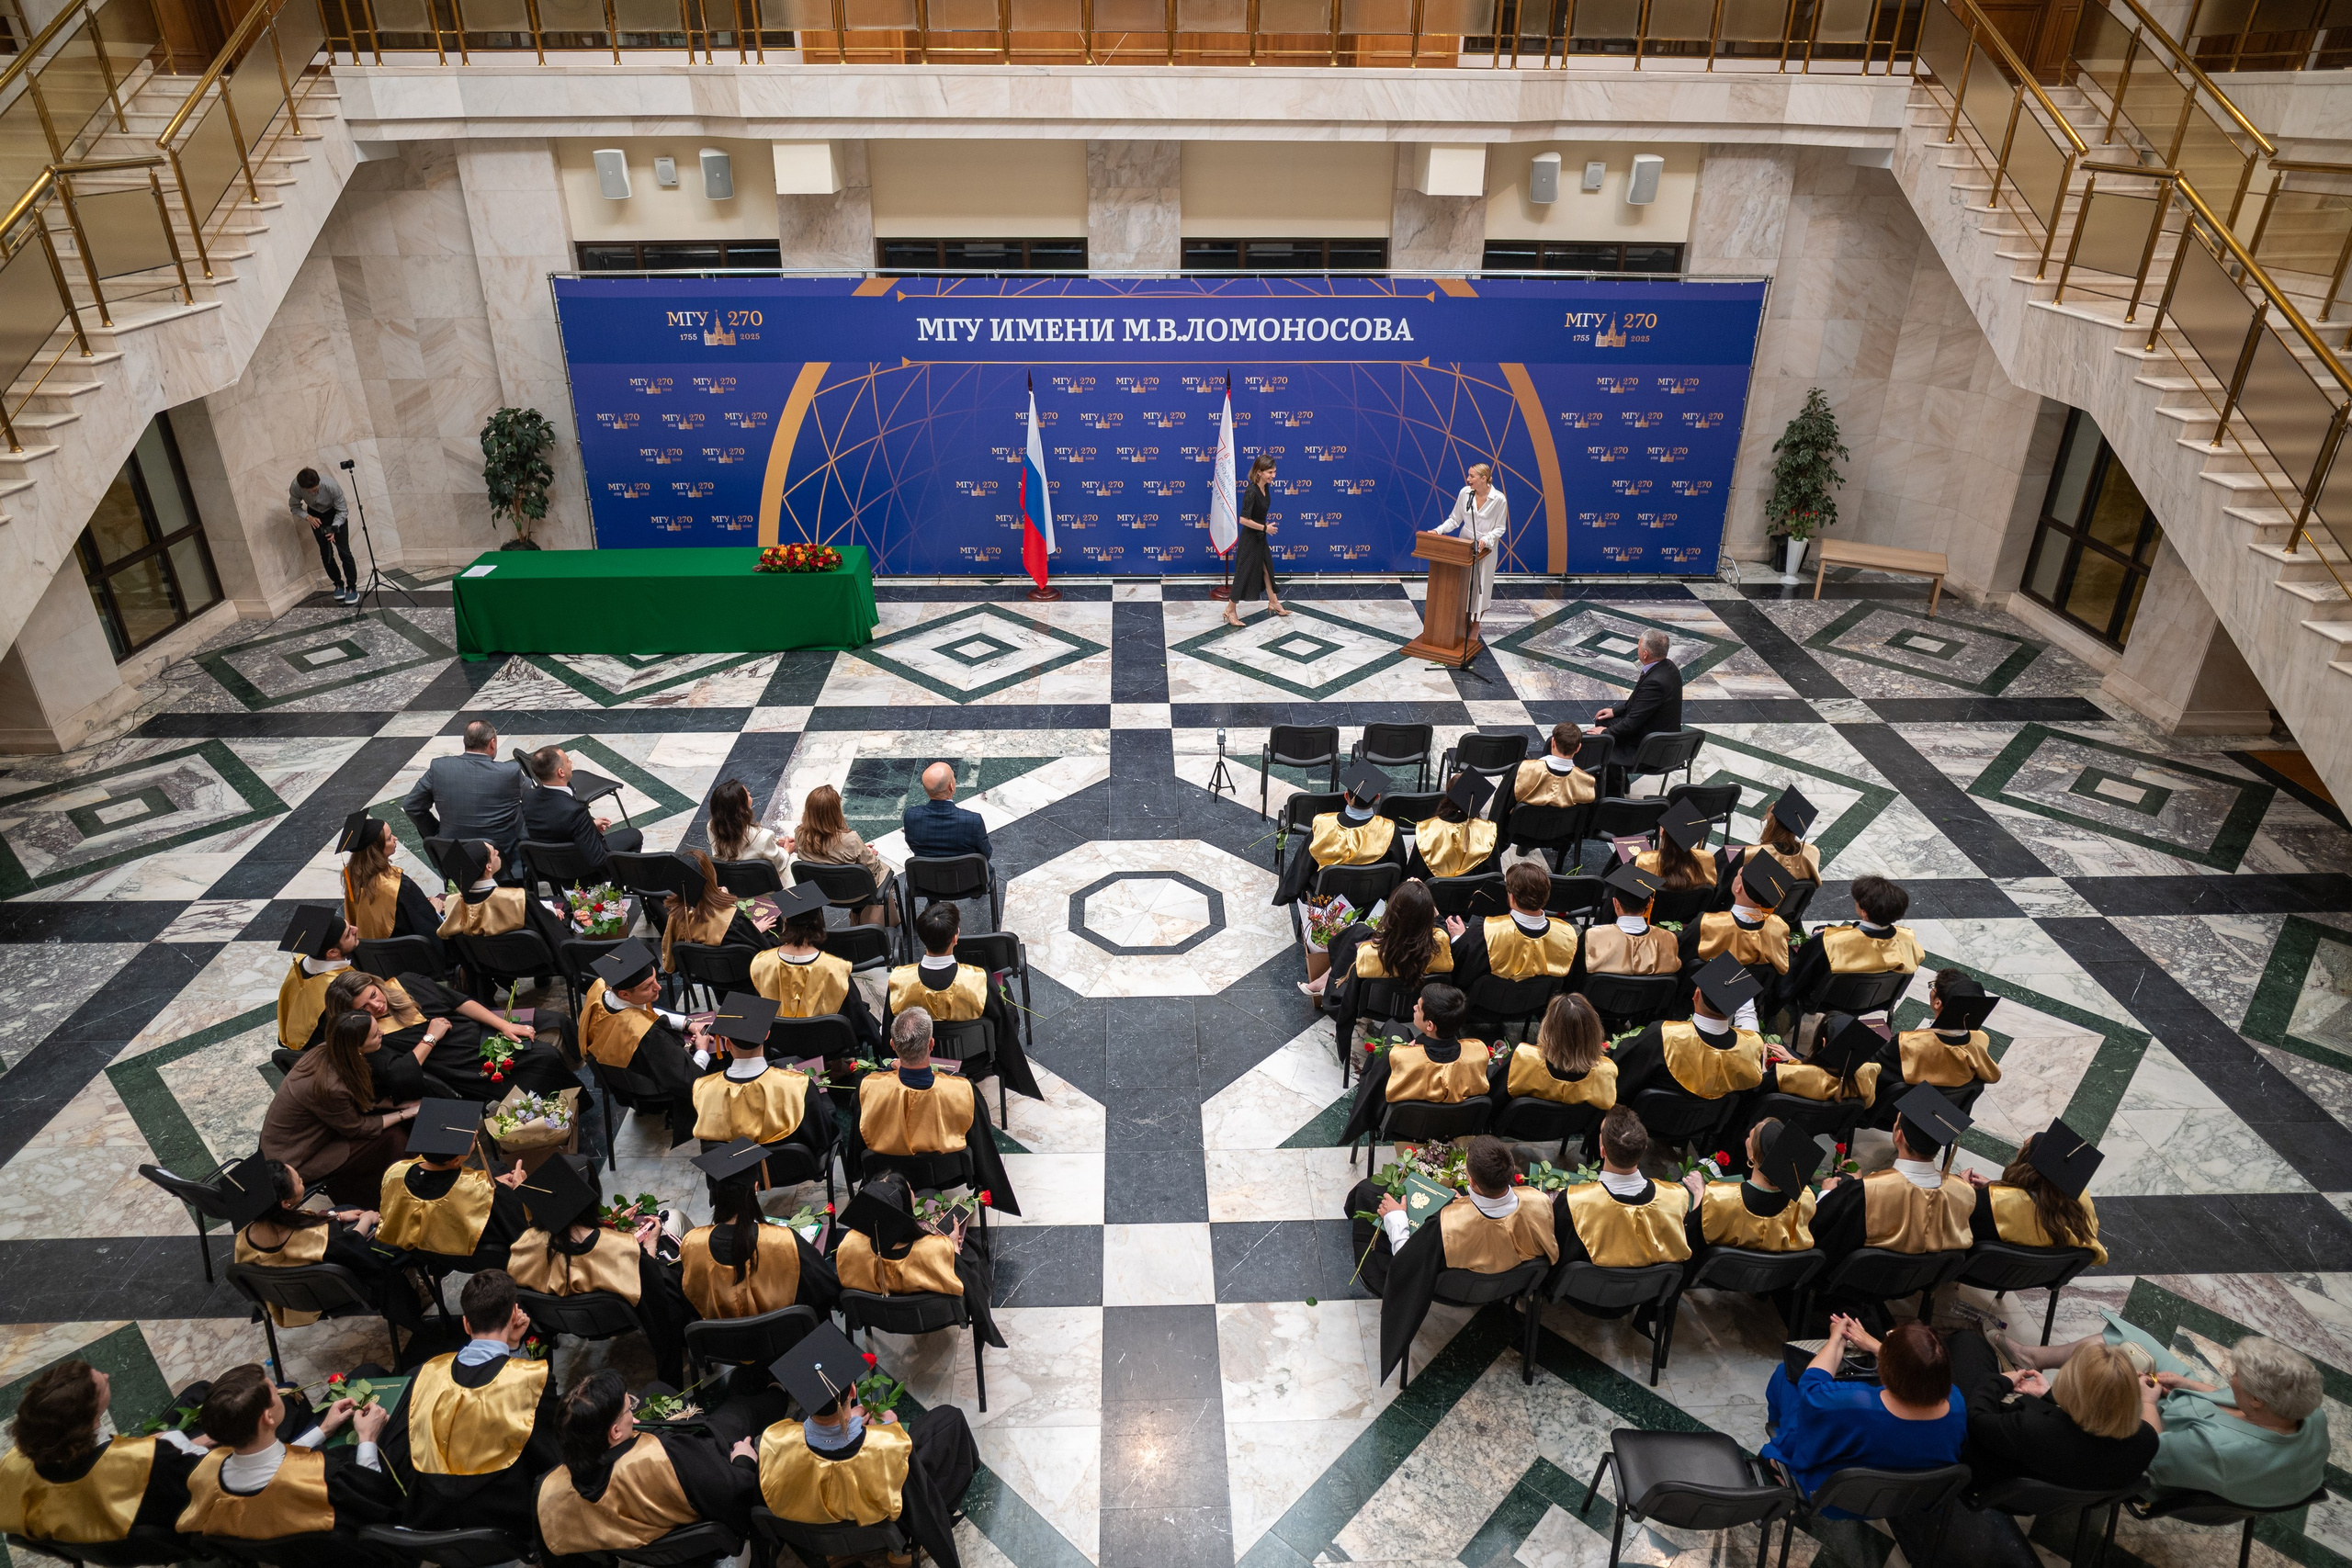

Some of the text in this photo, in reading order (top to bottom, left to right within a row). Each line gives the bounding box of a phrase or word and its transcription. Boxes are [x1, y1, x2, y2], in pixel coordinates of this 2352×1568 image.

[666, 310, 763, 326] МГУ 270
[1565, 313, 1657, 329] МГУ 270
[916, 318, 983, 342] МГУ
[989, 318, 1114, 342] ИМЕНИ
